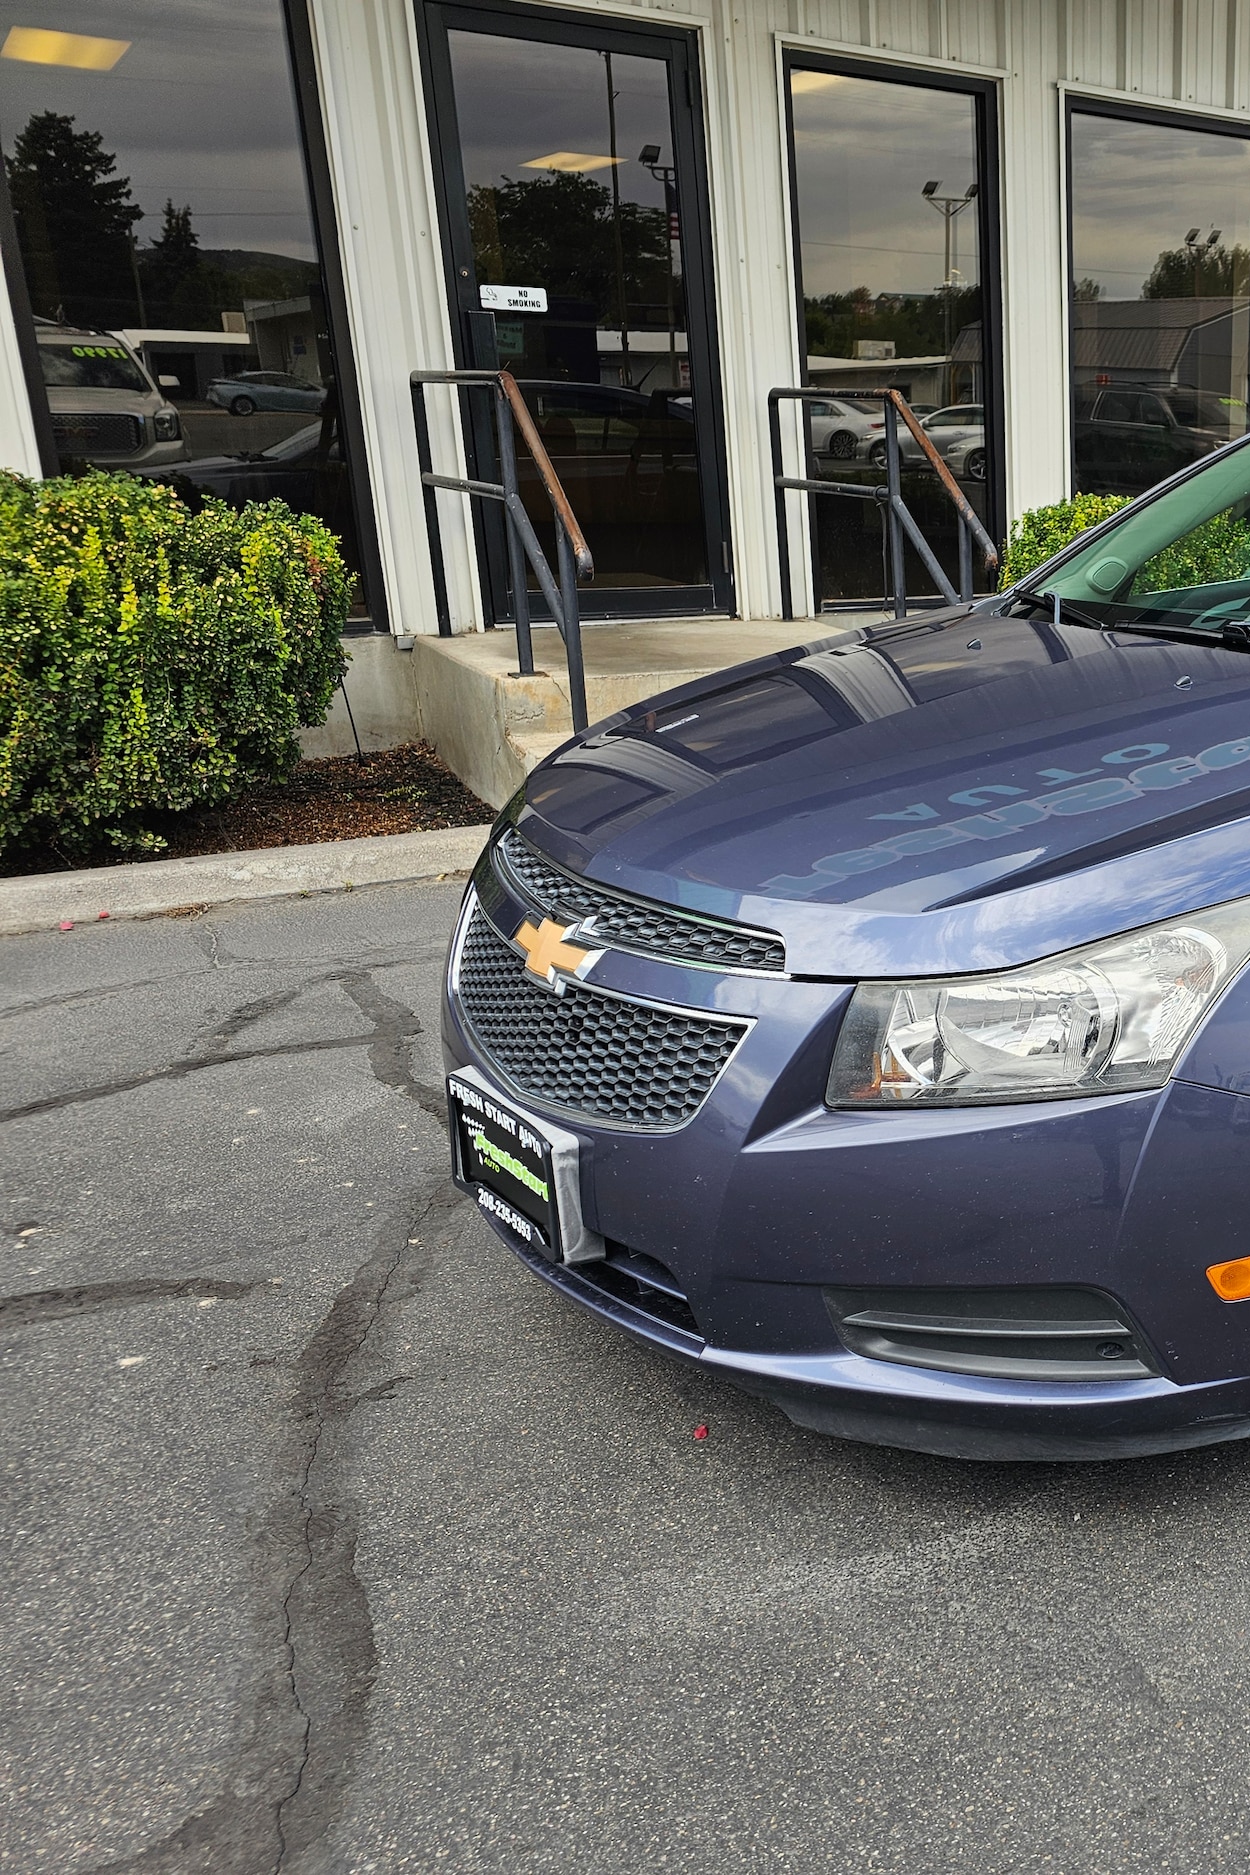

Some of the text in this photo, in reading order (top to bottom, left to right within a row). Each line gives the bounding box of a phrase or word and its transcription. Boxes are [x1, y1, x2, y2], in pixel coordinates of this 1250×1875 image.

[518, 290, 528, 298] NO
[507, 299, 541, 308] SMOKING
[449, 1079, 543, 1159] FRESH START AUTO
[484, 1157, 500, 1173] AUTO
[478, 1188, 532, 1241] 208-235-5353
